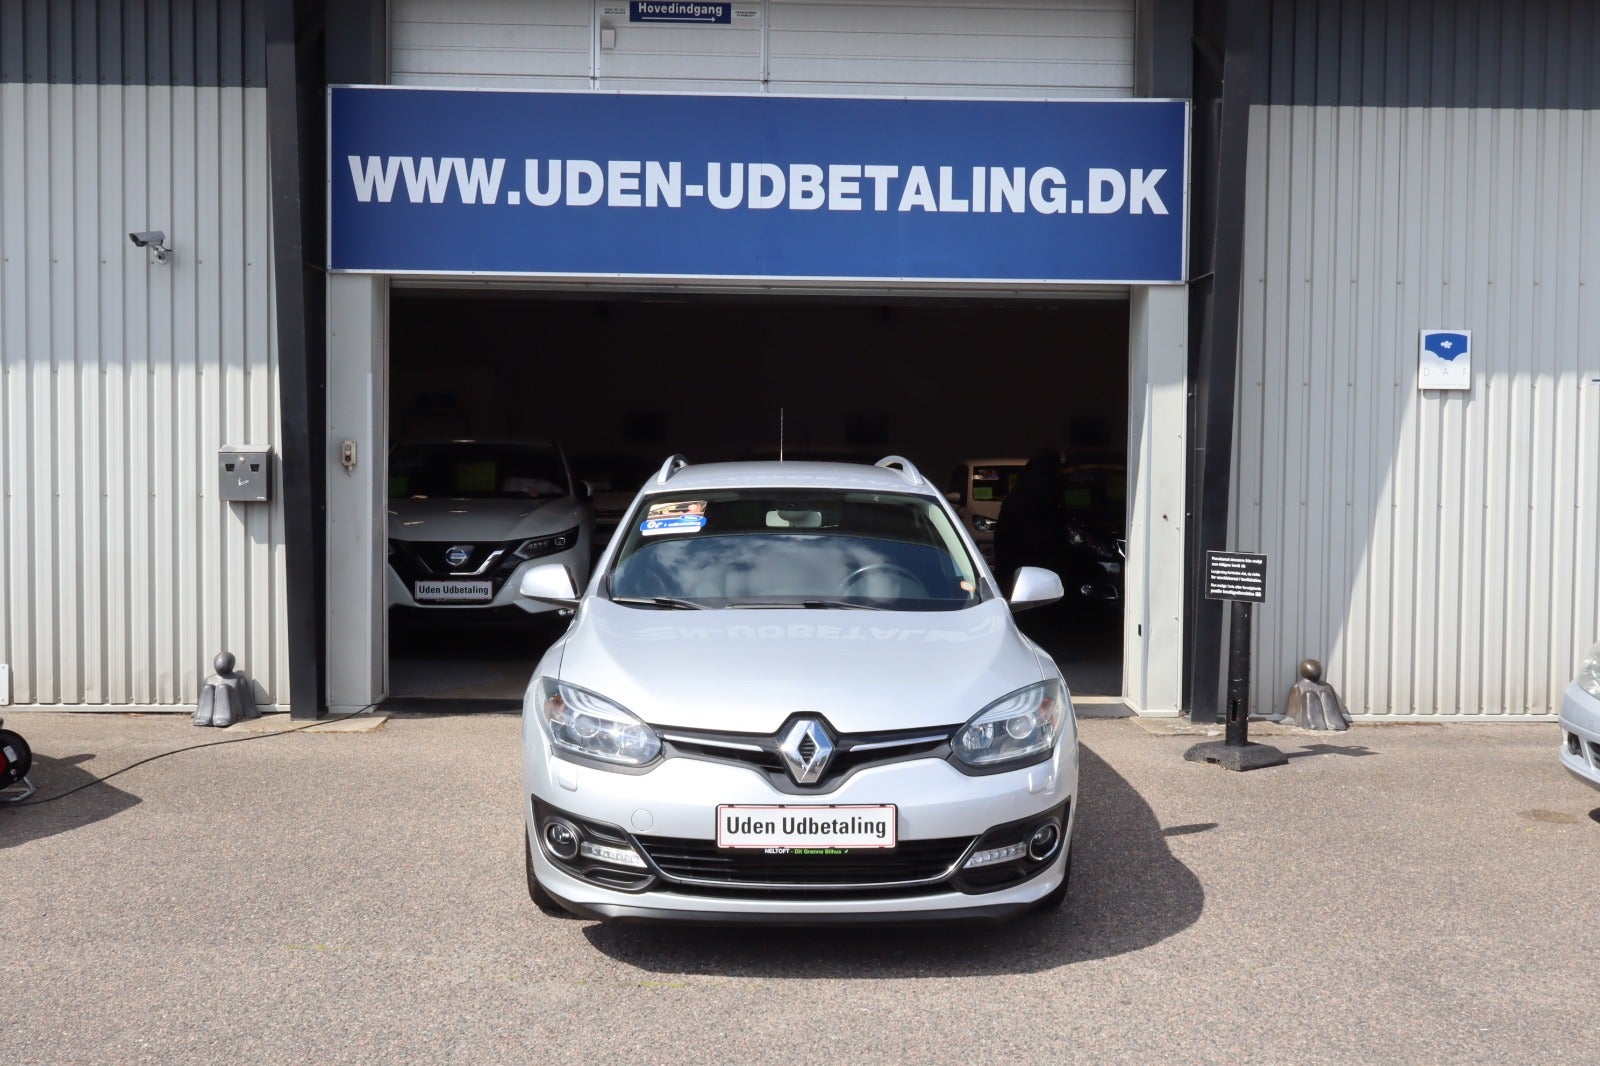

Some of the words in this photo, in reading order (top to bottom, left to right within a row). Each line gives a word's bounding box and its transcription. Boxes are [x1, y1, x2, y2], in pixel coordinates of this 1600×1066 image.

[638, 2, 723, 16] Hovedindgang
[347, 154, 1169, 215] WWW.UDEN-UDBETALING.DK
[418, 585, 441, 594] Uden
[442, 585, 489, 596] Udbetaling
[726, 816, 776, 834] Uden
[782, 816, 887, 839] Udbetaling
